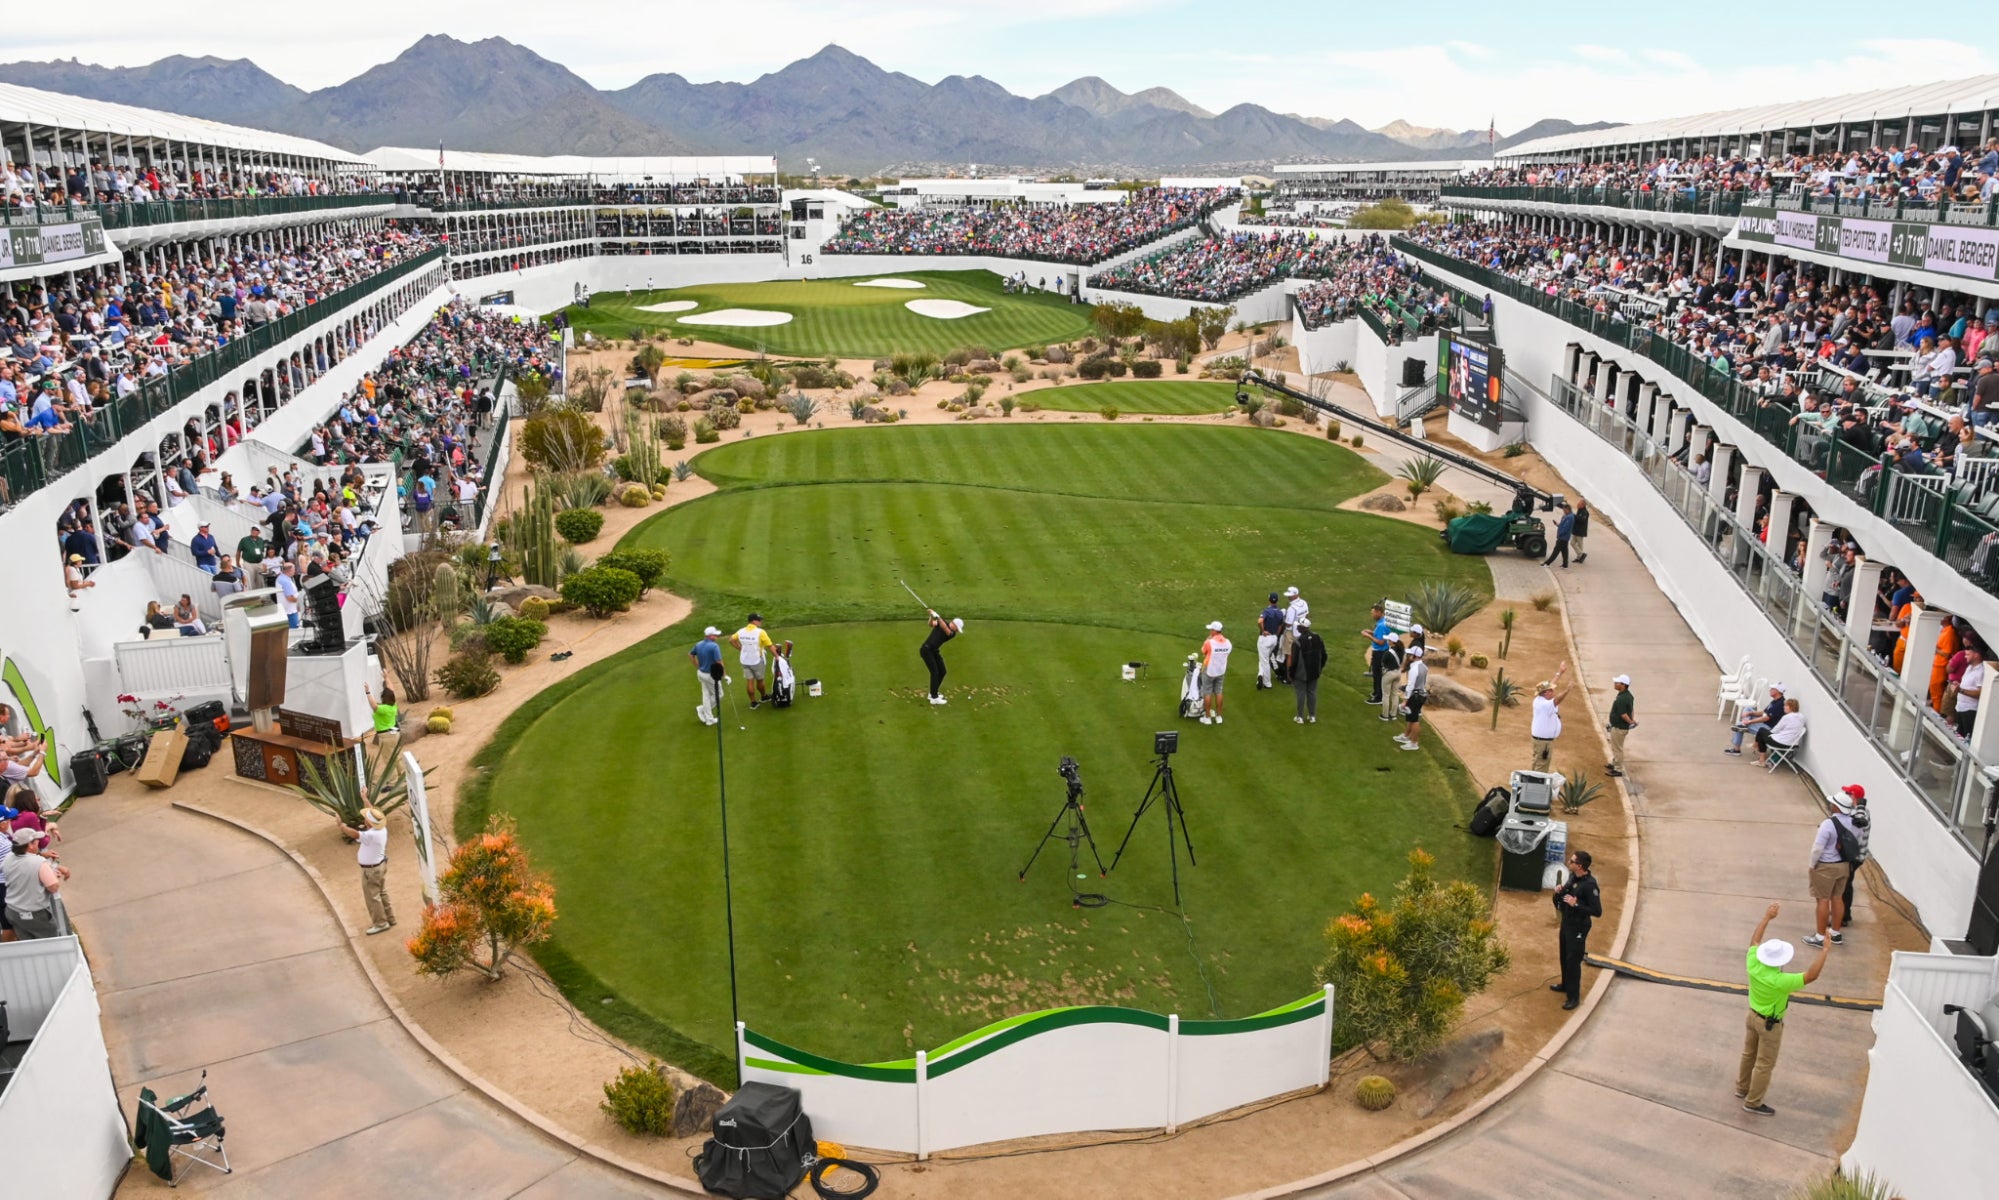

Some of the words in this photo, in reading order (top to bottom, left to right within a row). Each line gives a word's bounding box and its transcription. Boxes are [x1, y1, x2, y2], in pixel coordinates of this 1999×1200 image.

[14, 236, 24, 256] +3
[42, 235, 62, 254] DANIEL
[62, 230, 83, 251] BERGER
[85, 229, 92, 246] -1
[1751, 217, 1776, 235] PLAYING
[1775, 219, 1792, 236] BILLY
[1792, 221, 1815, 242] HORSCHEL
[1818, 225, 1825, 243] -3
[1827, 226, 1839, 245] T14
[1842, 228, 1853, 247] TED
[1852, 229, 1877, 255] POTTER,
[1878, 232, 1888, 252] JR.
[1893, 234, 1904, 254] +3
[1906, 234, 1925, 257] T118
[1928, 237, 1956, 262] DANIEL
[1959, 240, 1995, 267] BERGER
[801, 254, 812, 264] 16
